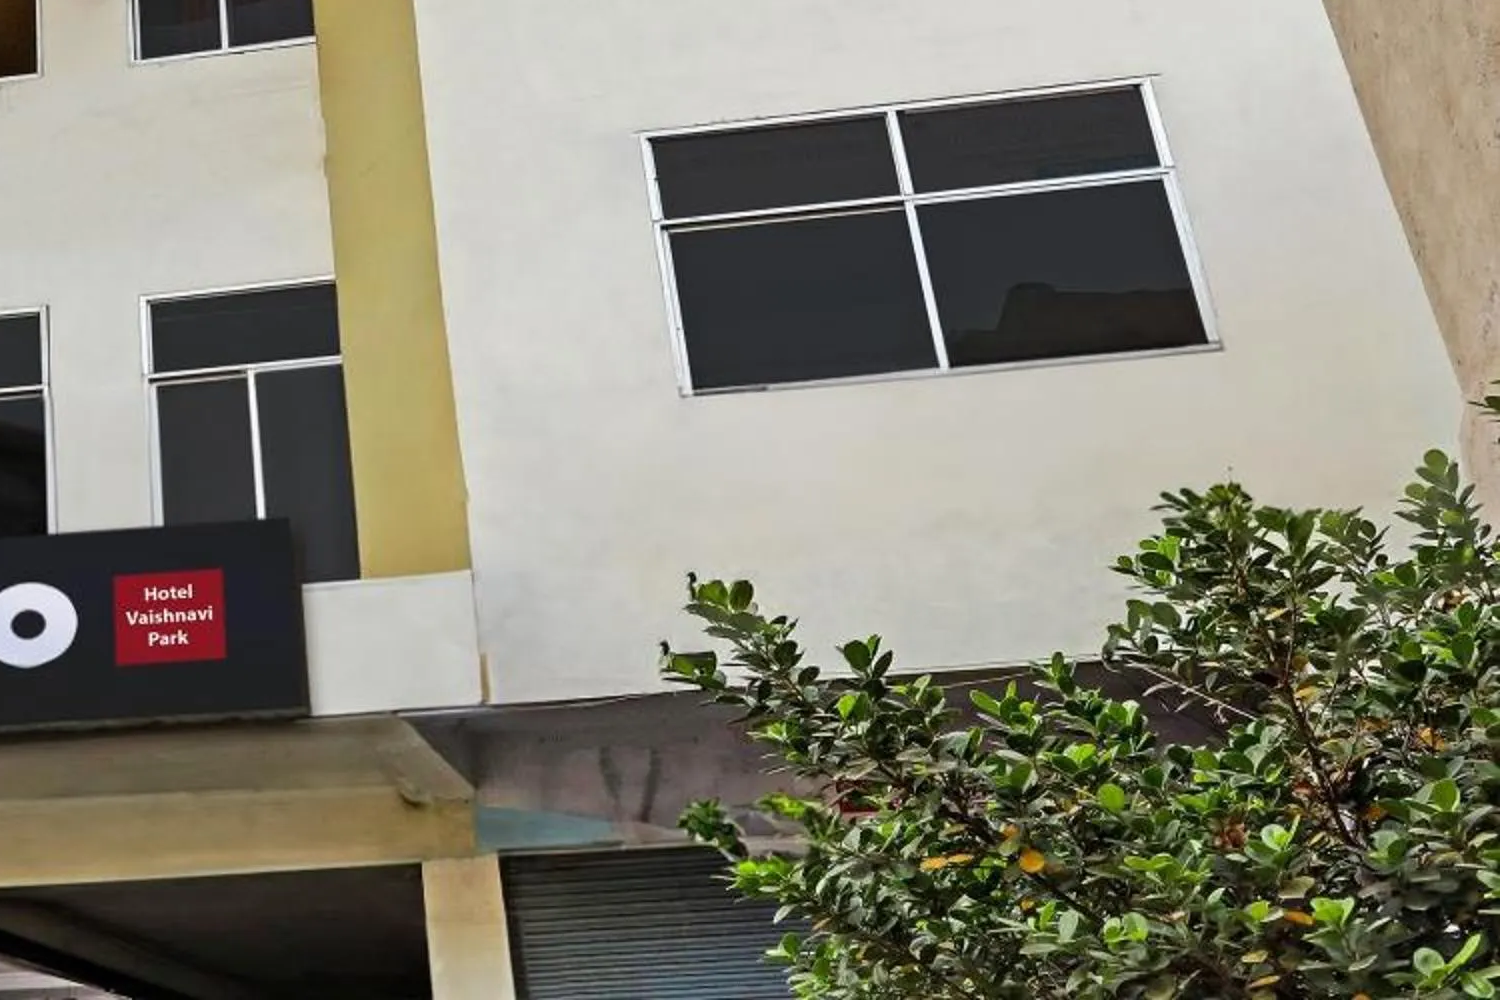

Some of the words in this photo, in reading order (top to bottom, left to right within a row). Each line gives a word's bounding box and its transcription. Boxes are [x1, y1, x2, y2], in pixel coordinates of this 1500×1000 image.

[144, 583, 193, 602] Hotel
[125, 606, 213, 625] Vaishnavi
[148, 629, 189, 647] Park
